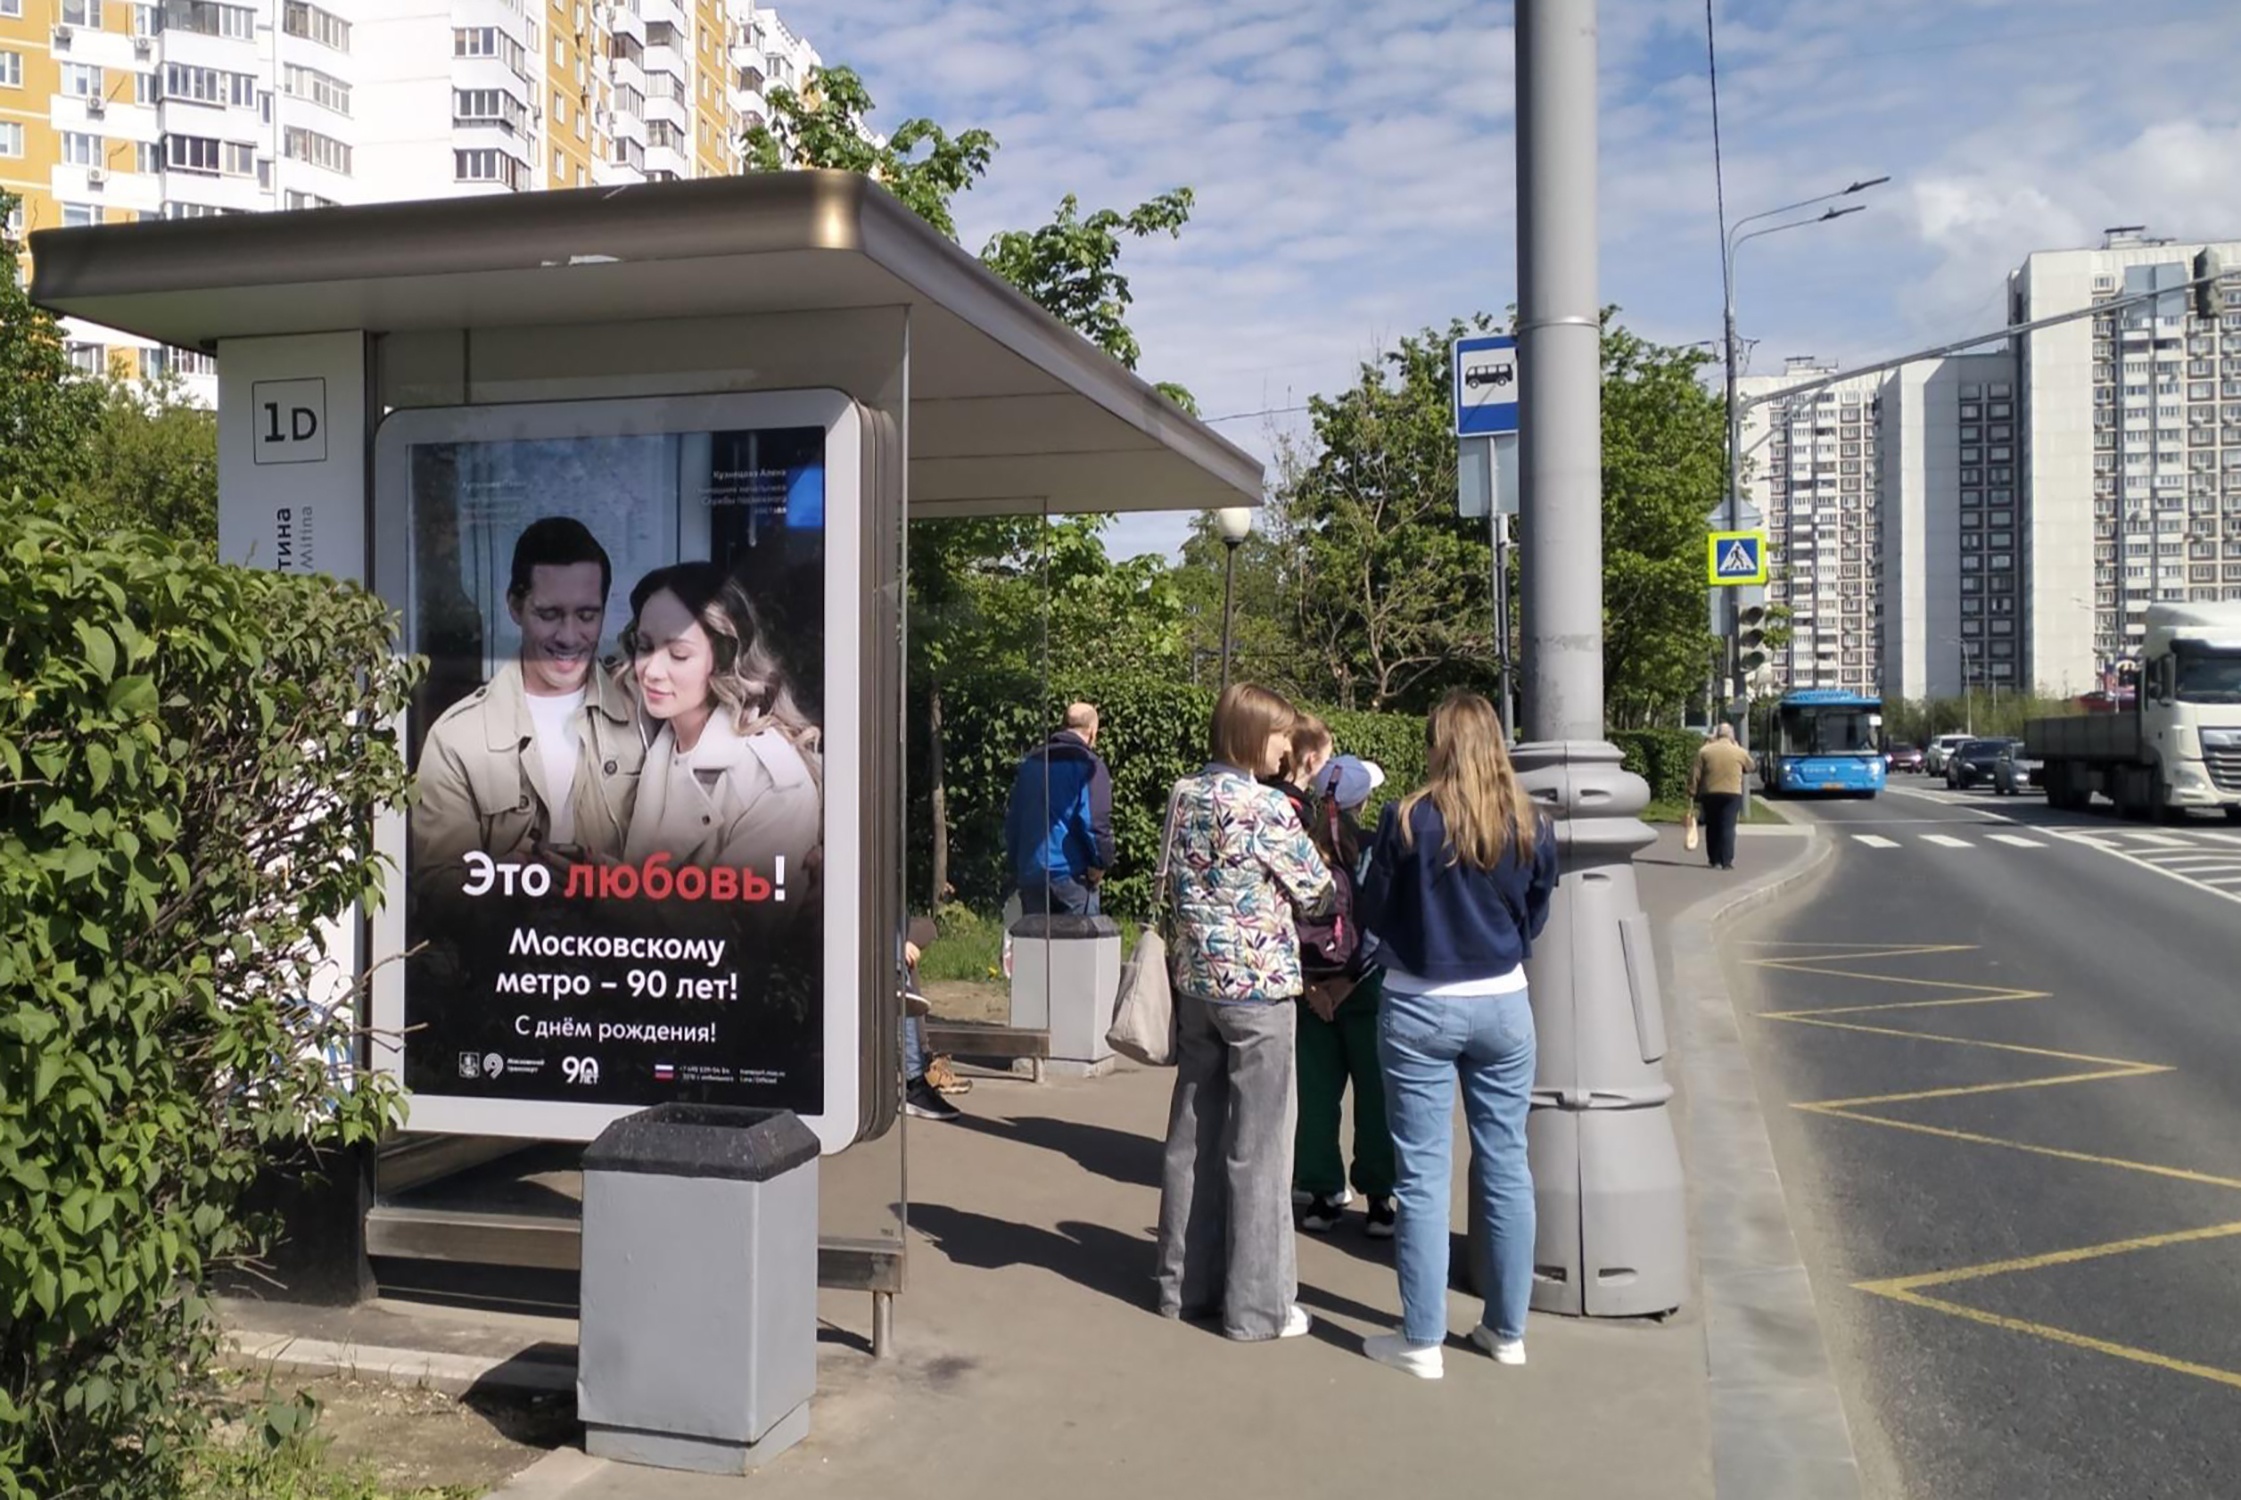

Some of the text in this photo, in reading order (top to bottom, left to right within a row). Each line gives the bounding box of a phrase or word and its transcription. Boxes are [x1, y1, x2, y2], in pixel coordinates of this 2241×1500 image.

[264, 402, 317, 443] 1D
[277, 508, 292, 571] тина
[462, 851, 786, 902] Это любовь!
[509, 928, 725, 967] Московскому
[495, 972, 591, 1000] метро
[627, 969, 668, 998] 90
[675, 972, 737, 1000] лет!
[515, 1015, 716, 1043] С днём рождения!
